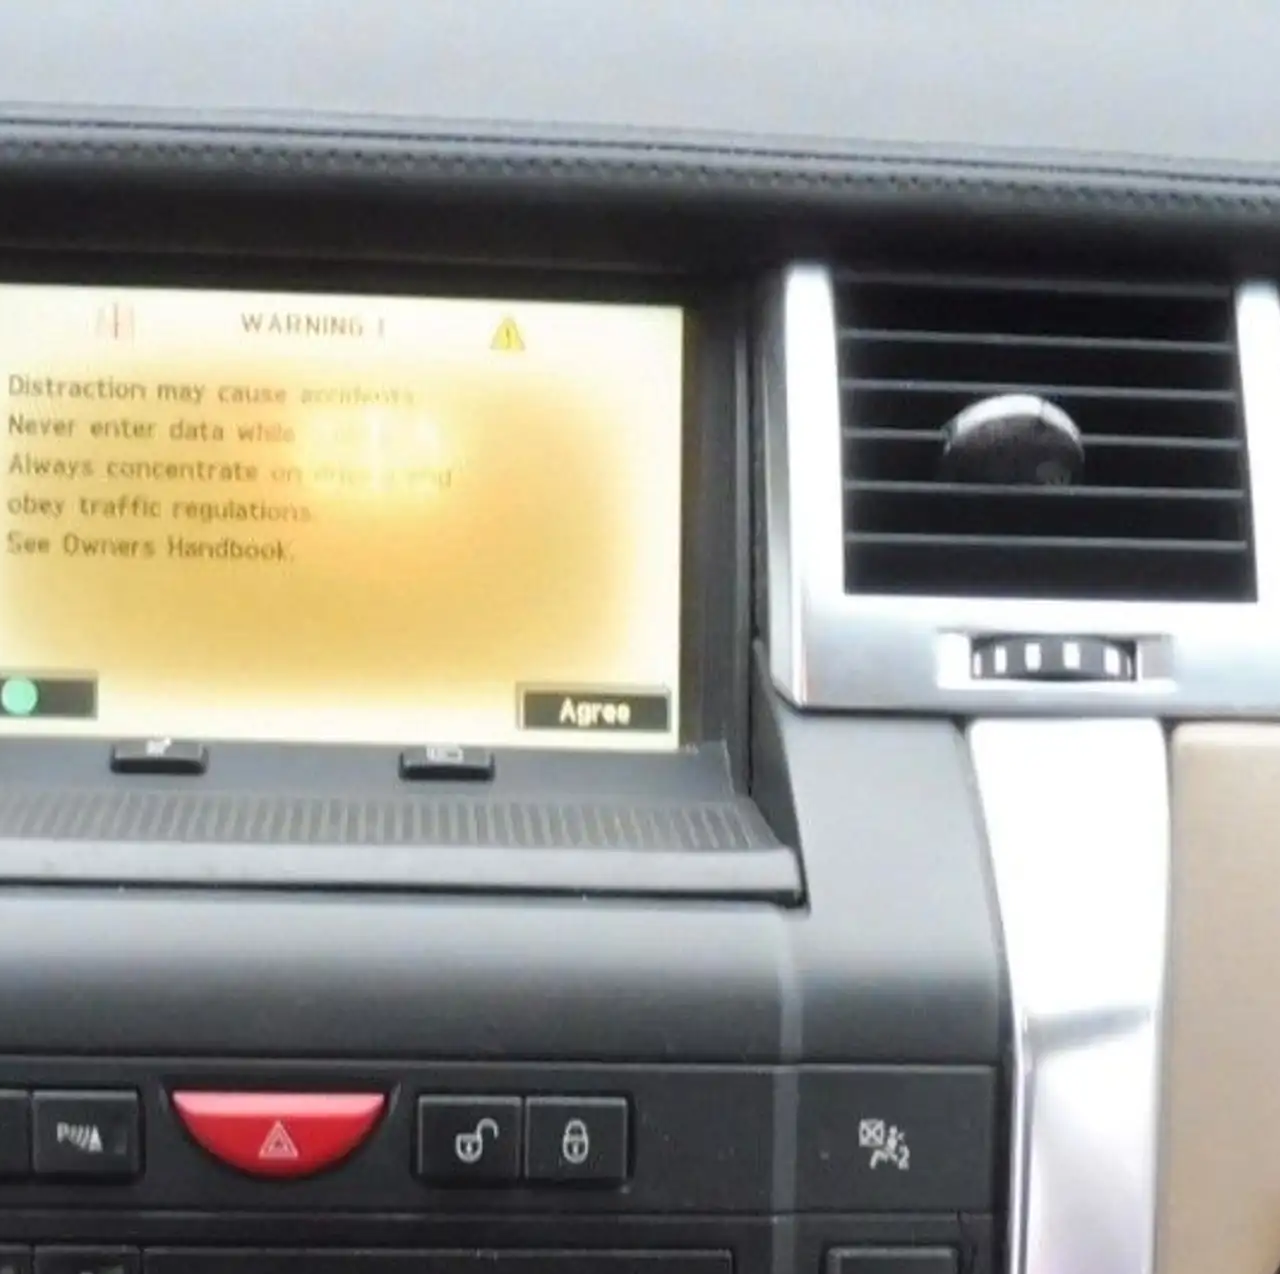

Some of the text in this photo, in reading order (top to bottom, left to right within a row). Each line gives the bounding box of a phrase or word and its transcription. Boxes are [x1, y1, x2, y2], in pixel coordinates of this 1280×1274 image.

[240, 311, 365, 338] WARNING
[7, 373, 147, 401] Distraction
[156, 381, 207, 407] may
[217, 386, 289, 404] cause
[7, 412, 77, 440] Never
[89, 417, 157, 441] enter
[168, 418, 225, 442] data
[236, 420, 296, 443] while
[7, 452, 95, 482] Always
[106, 458, 259, 482] concentrate
[6, 491, 65, 520] obey
[78, 490, 162, 519] traffic
[6, 529, 51, 555] See
[62, 531, 157, 558] Owners
[559, 694, 632, 727] Agree
